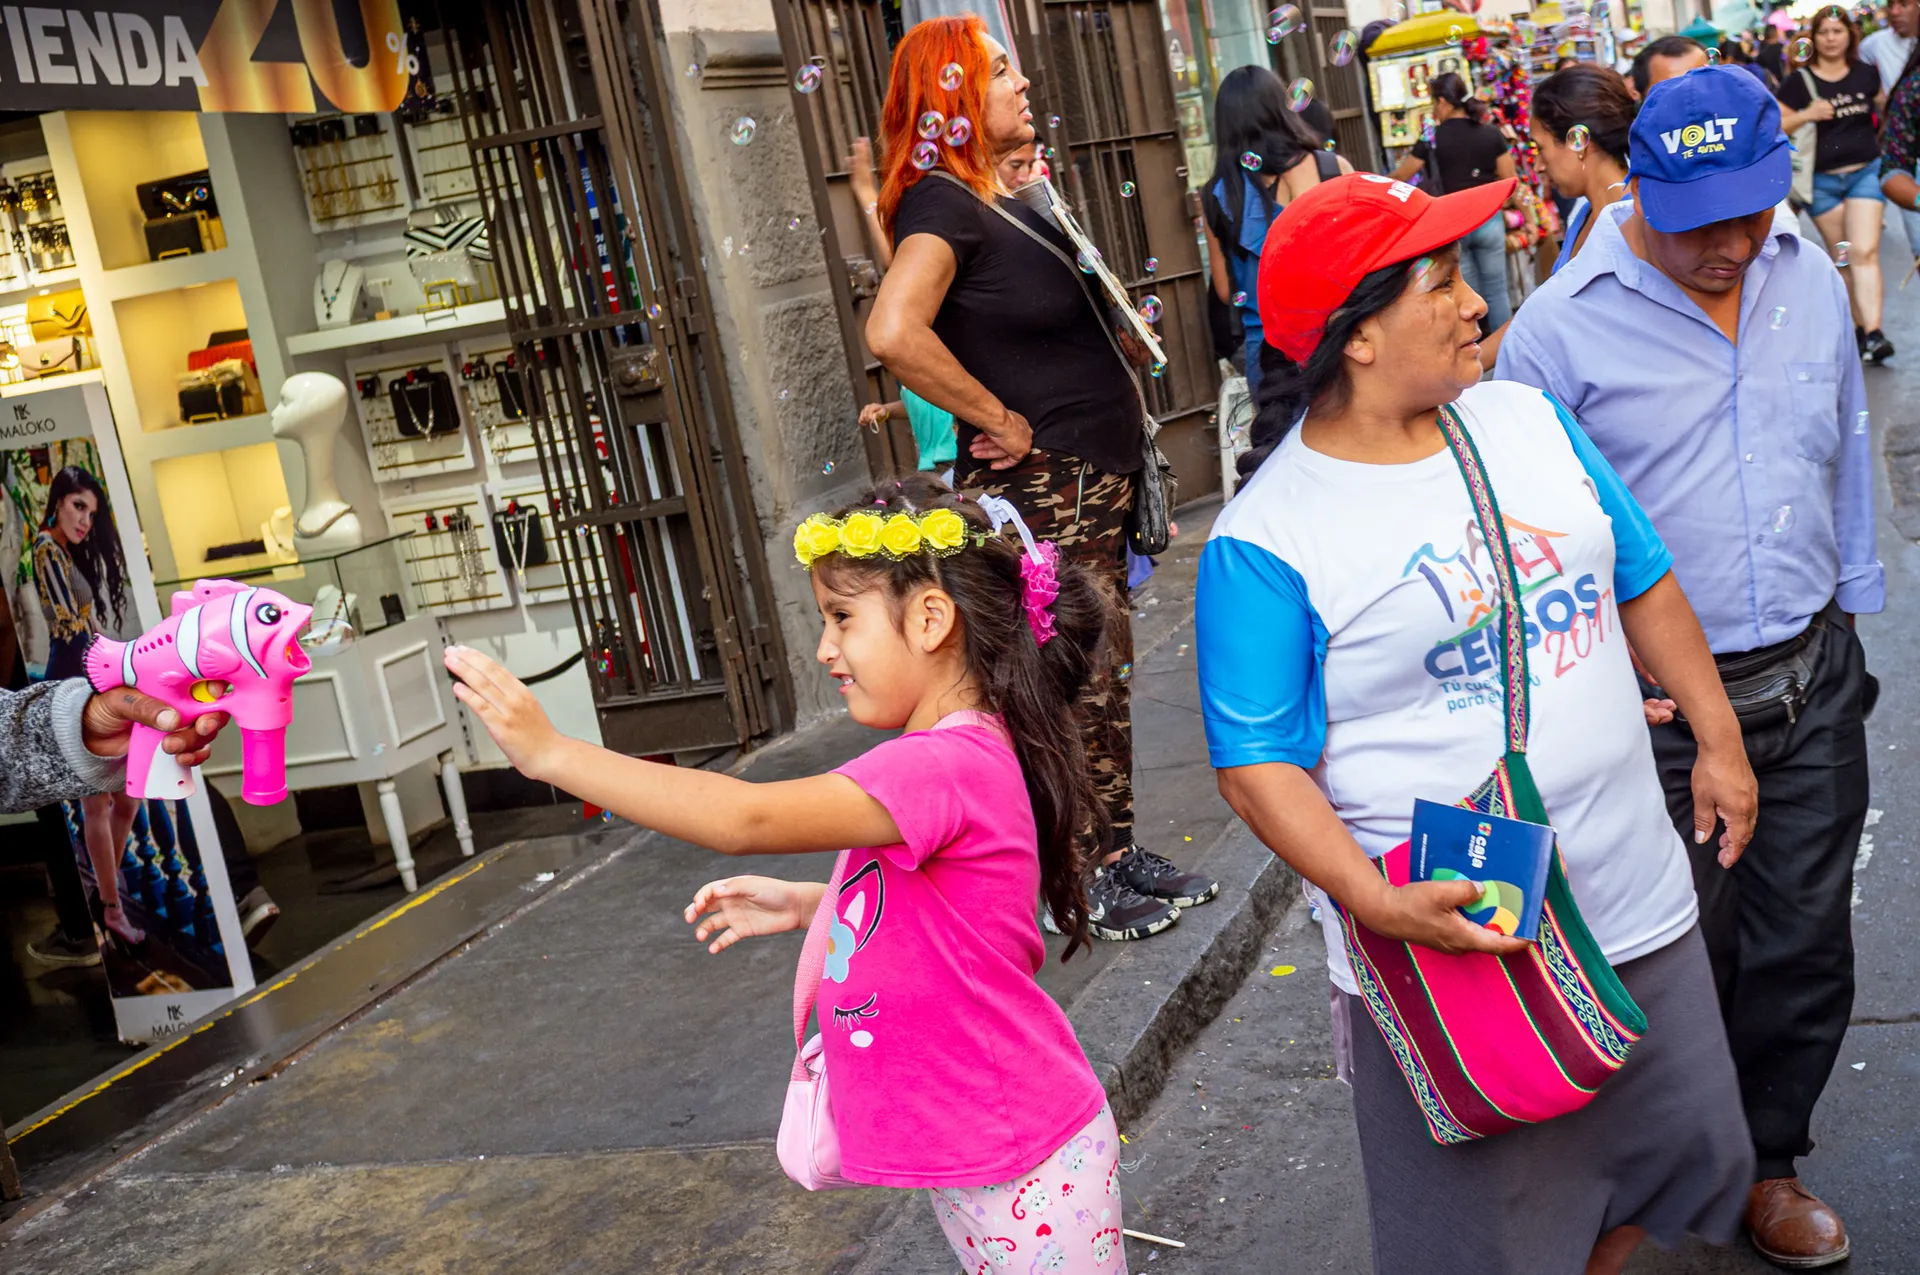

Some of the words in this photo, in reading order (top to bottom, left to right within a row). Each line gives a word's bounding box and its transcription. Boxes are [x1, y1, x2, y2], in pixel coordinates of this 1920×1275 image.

[0, 6, 209, 87] IENDA
[1660, 117, 1739, 154] VOLT
[1681, 148, 1694, 160] TE
[0, 418, 56, 440] MALOKO
[1544, 587, 1613, 679] 2017
[1447, 694, 1485, 714] para
[1471, 835, 1487, 869] caja
